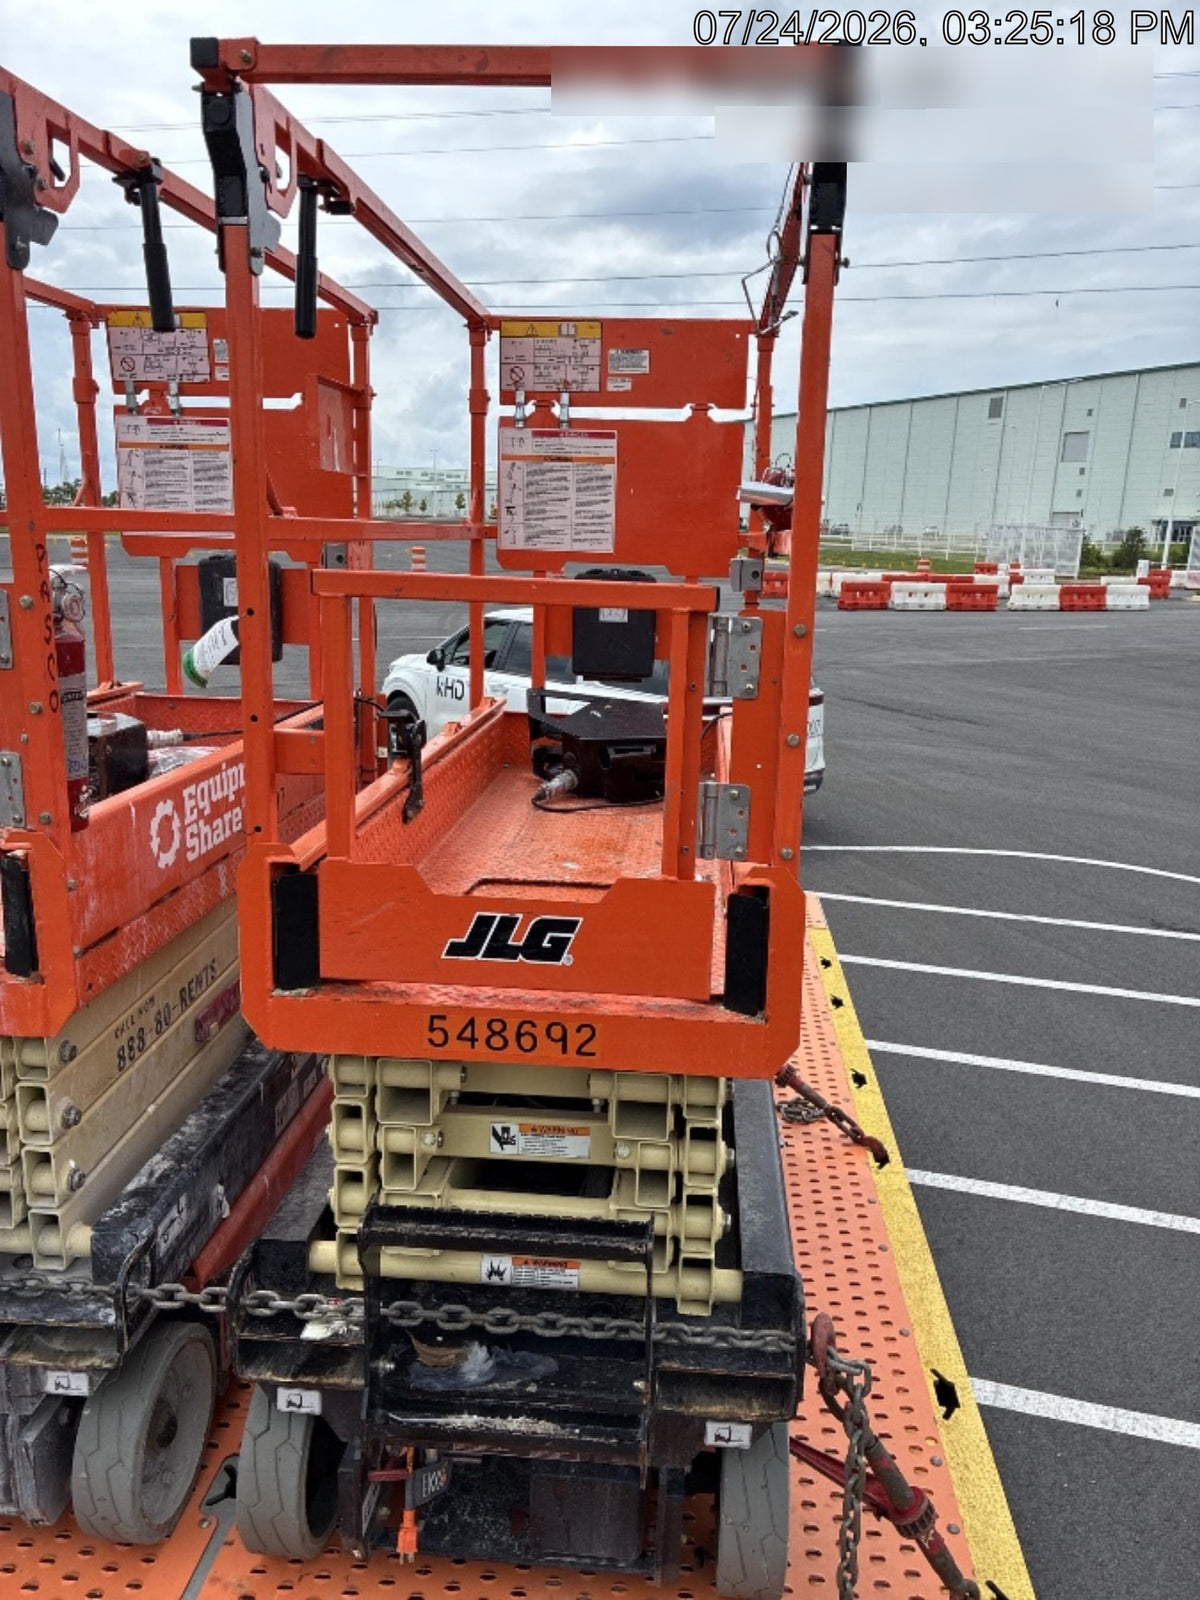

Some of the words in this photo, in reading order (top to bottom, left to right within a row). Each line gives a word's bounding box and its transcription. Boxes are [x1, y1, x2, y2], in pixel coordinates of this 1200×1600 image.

[35, 543, 59, 713] PASCO
[186, 806, 242, 862] Share
[441, 912, 583, 965] JLG
[427, 1014, 598, 1057] 548692
